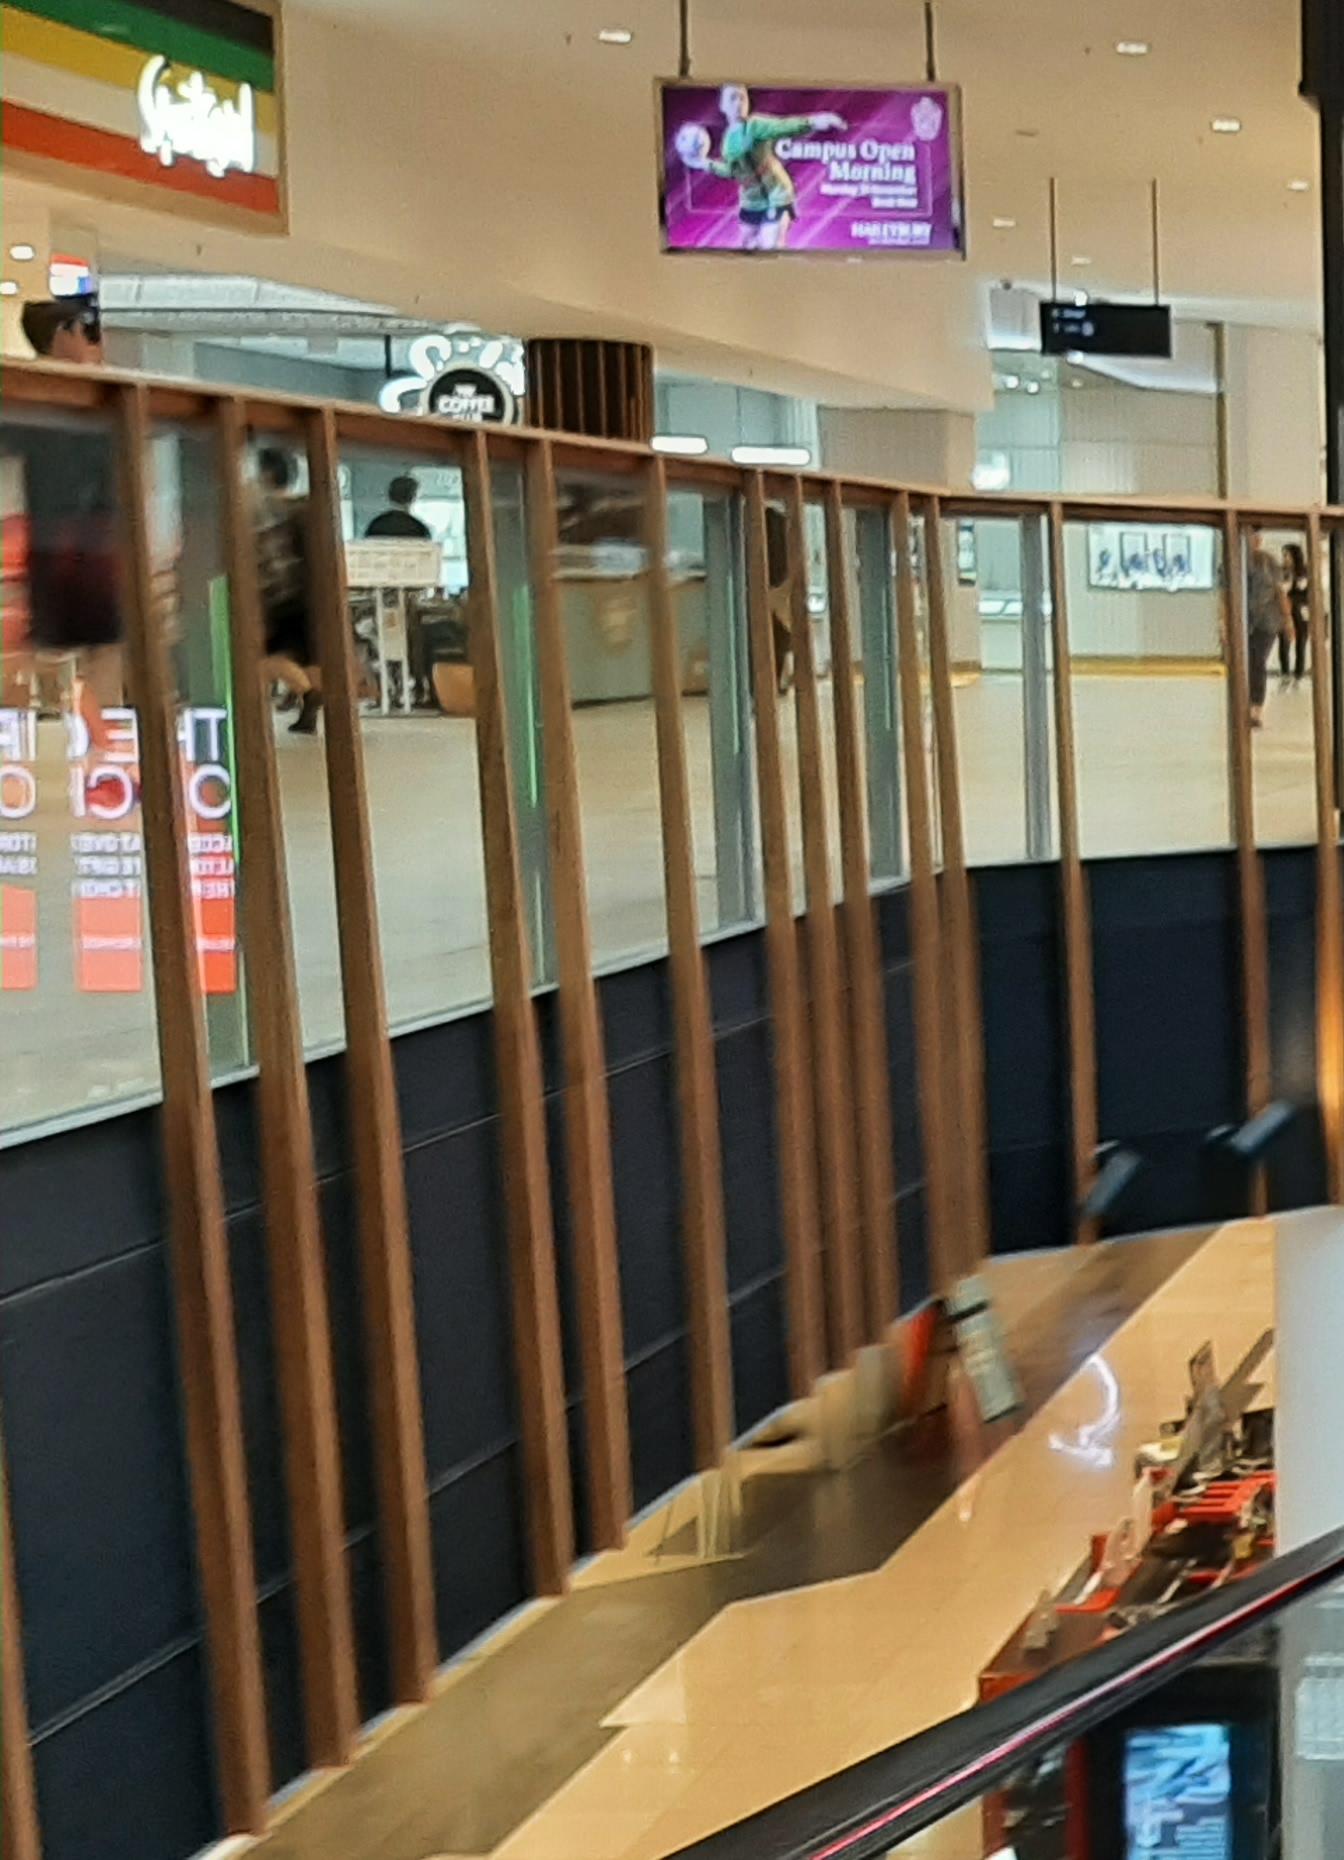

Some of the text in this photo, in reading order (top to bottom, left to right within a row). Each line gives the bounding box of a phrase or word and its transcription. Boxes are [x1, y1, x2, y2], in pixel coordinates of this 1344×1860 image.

[775, 138, 916, 165] Campus Open
[829, 160, 917, 184] Morning
